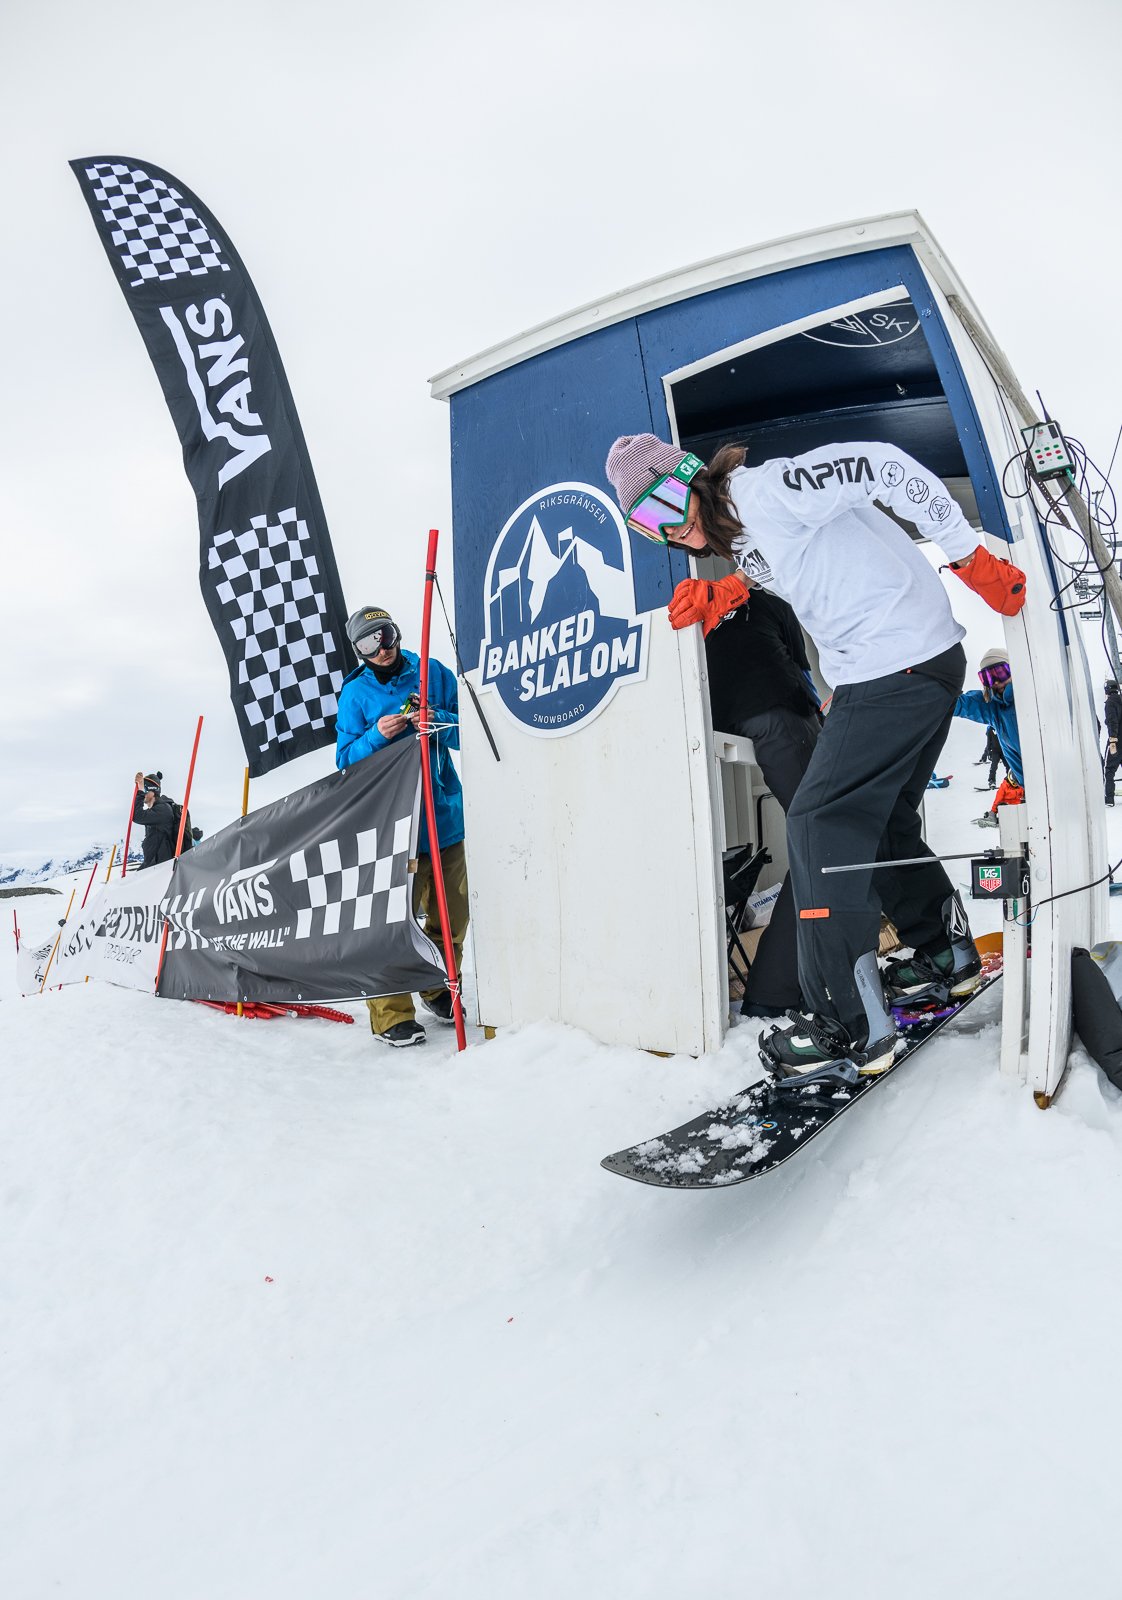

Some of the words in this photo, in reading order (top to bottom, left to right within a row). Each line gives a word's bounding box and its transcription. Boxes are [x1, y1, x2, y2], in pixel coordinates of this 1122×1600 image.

[159, 297, 272, 491] VANS
[540, 494, 607, 524] RIKSGRÄNSEN
[486, 609, 595, 679] BANKED
[519, 632, 638, 701] SLALOM
[533, 703, 585, 724] SNOWBOARD
[981, 879, 1001, 891] HEUER
[982, 868, 998, 878] TAG
[213, 858, 278, 924] VANS
[225, 933, 248, 950] THE
